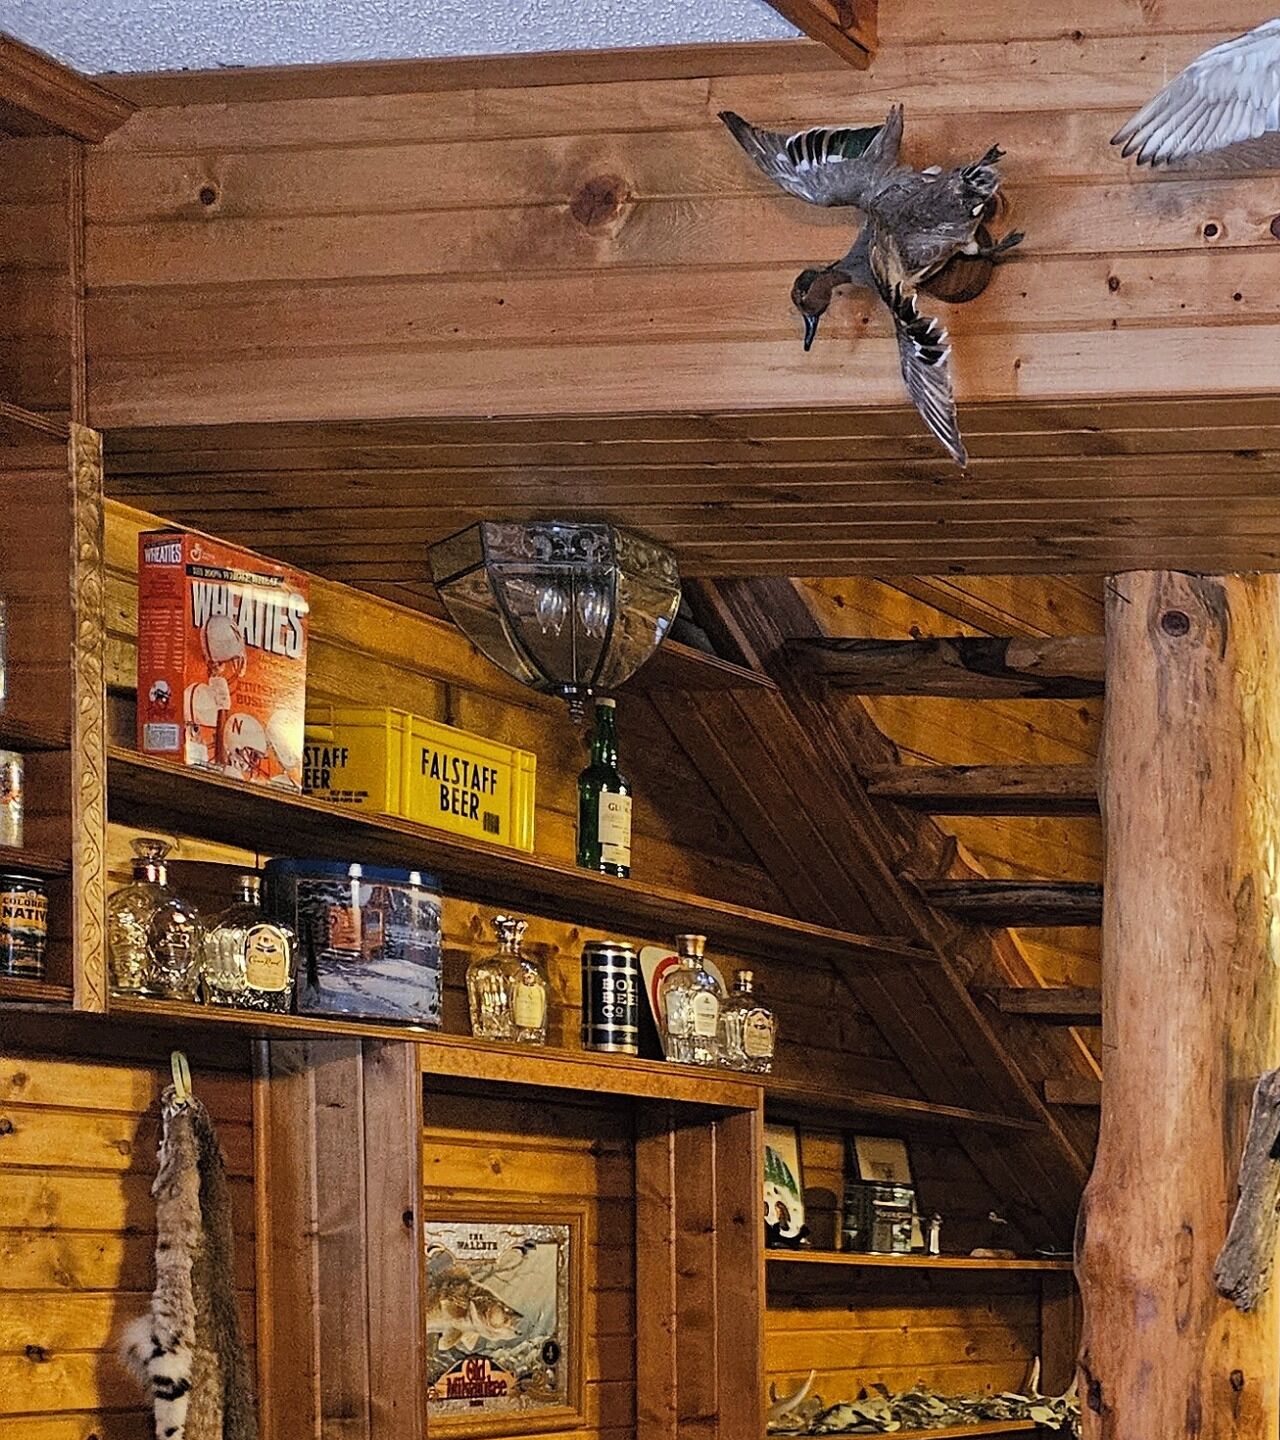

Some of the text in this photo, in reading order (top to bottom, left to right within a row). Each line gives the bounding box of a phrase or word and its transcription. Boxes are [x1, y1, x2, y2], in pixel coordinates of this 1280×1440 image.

[144, 543, 182, 564] WHEATIES
[191, 580, 307, 660] WHEATIES
[303, 747, 349, 768] STAFF
[303, 768, 331, 789] EER
[421, 748, 498, 796] FALSTAFF
[440, 784, 479, 821] BEER
[3, 896, 48, 908] COLORA
[3, 905, 47, 922] NATIV
[457, 1241, 498, 1250] WALLEYE
[465, 1359, 486, 1382] Old
[446, 1374, 508, 1398] Milwaukee
